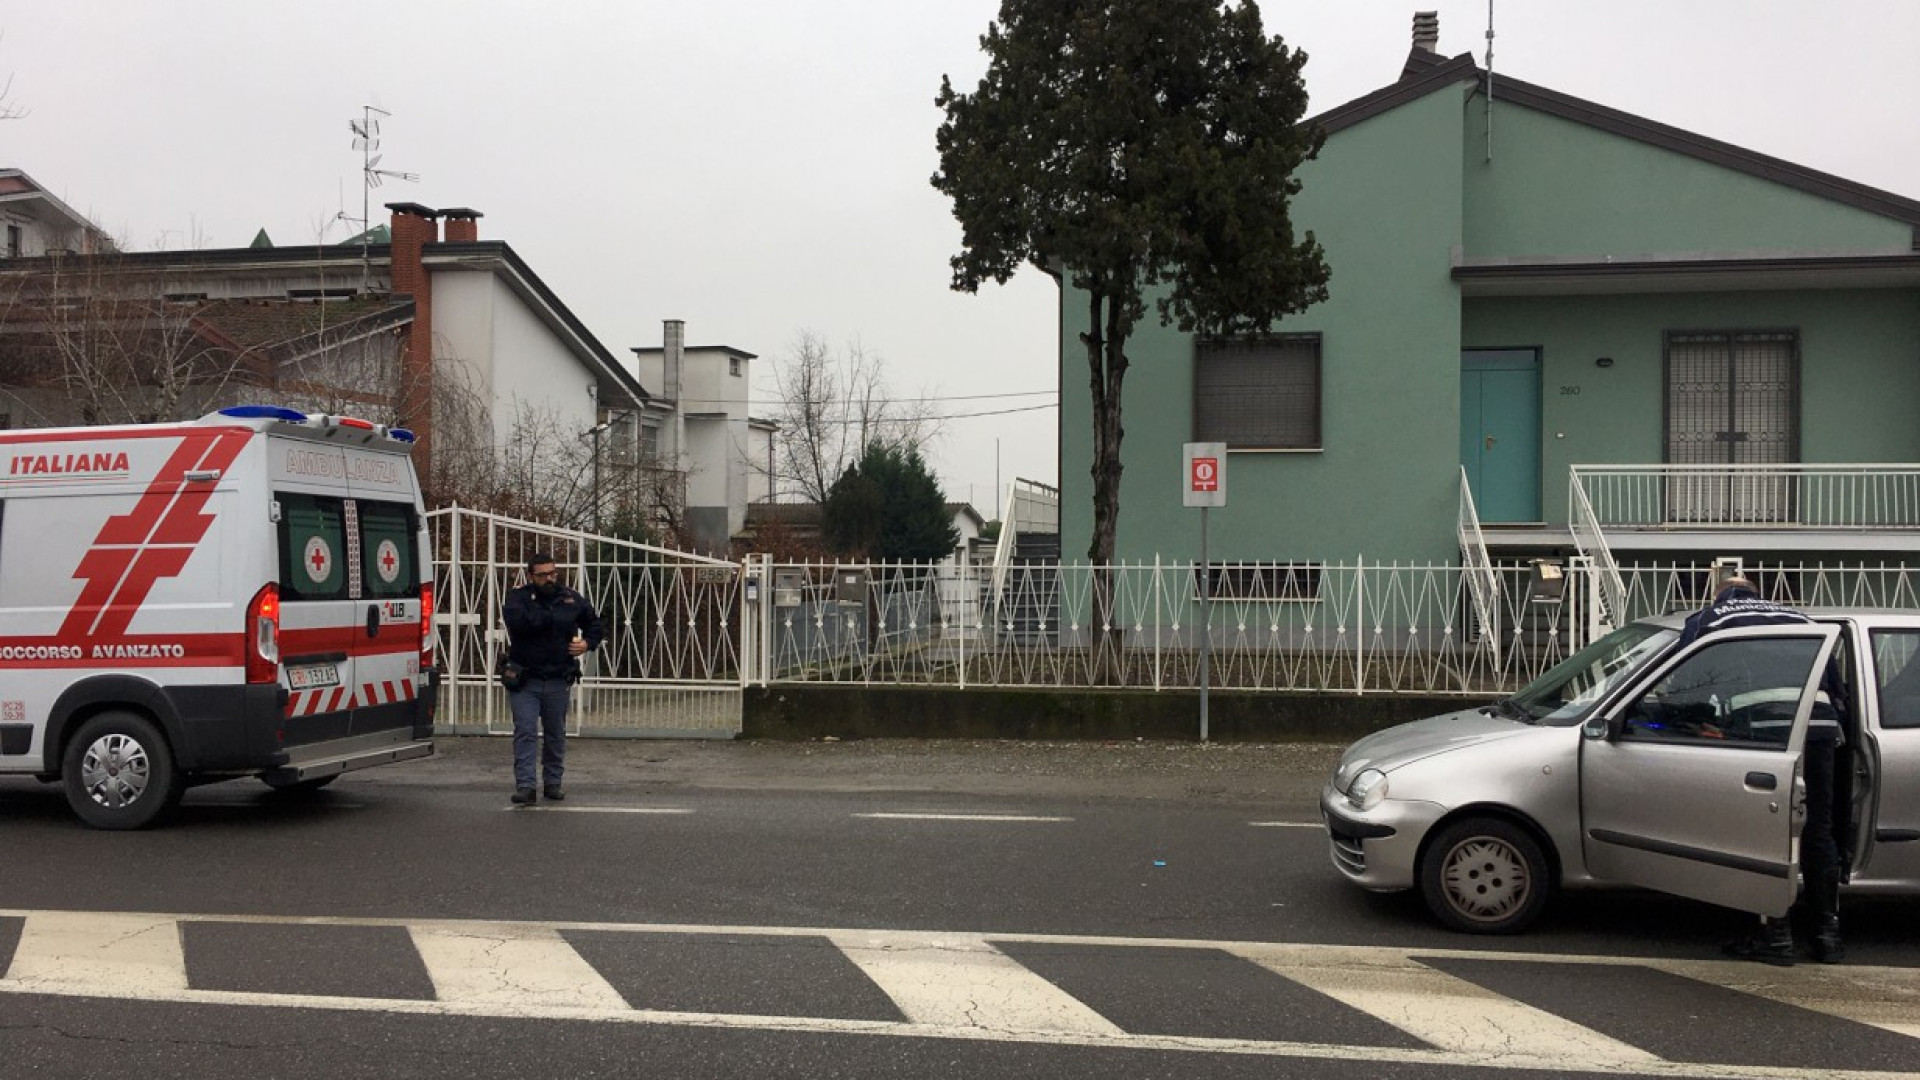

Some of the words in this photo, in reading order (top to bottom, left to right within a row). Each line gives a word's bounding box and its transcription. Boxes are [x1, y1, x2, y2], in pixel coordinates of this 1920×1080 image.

[10, 452, 130, 475] ITALIANA
[286, 449, 400, 484] AMBULANZA
[0, 646, 82, 660] OCCORSO
[92, 644, 185, 658] AVANZATO
